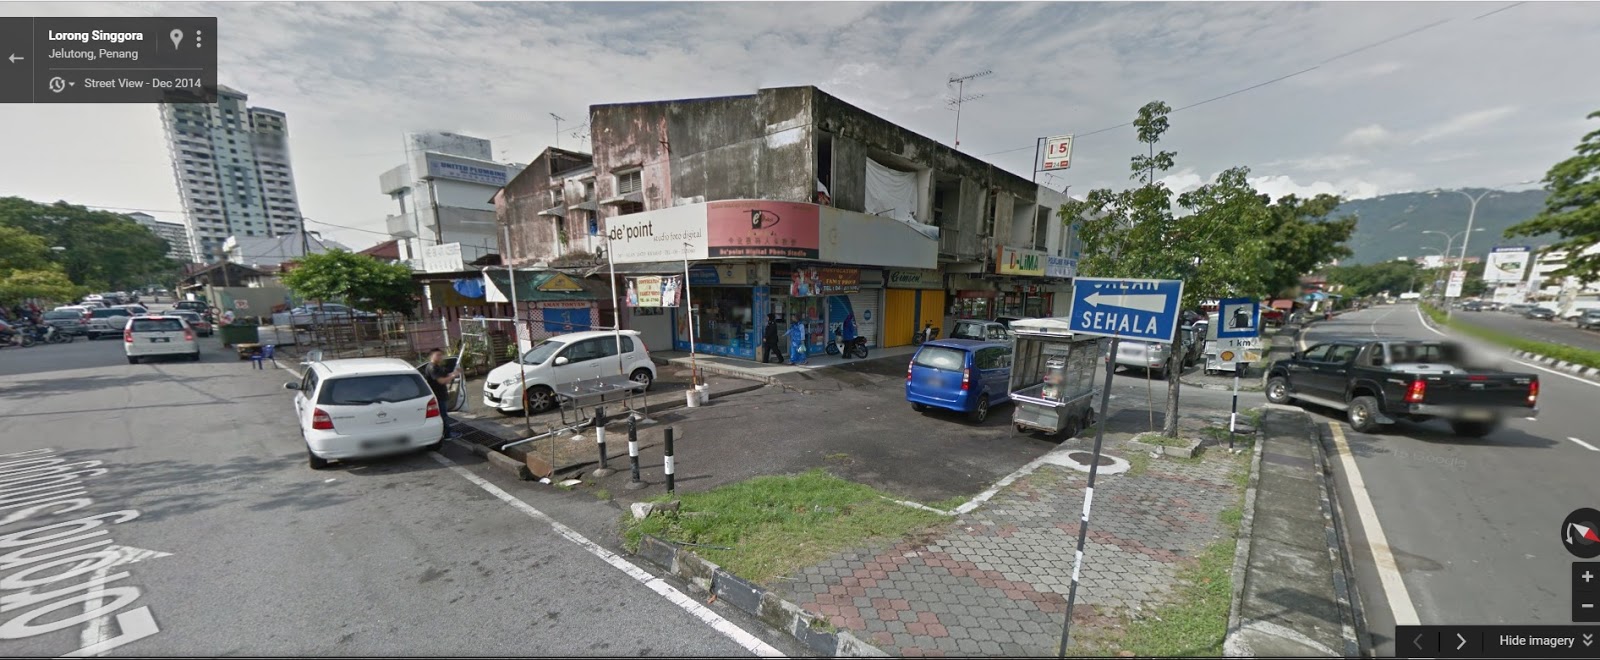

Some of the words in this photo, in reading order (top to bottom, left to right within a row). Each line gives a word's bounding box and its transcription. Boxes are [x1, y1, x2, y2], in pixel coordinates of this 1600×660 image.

[440, 161, 468, 171] UNITED
[469, 166, 507, 178] PLUMBING
[610, 220, 653, 243] de'point
[653, 231, 670, 242] studio
[682, 228, 702, 241] digital
[1081, 310, 1157, 335] SEHALA
[1229, 339, 1233, 347] 1
